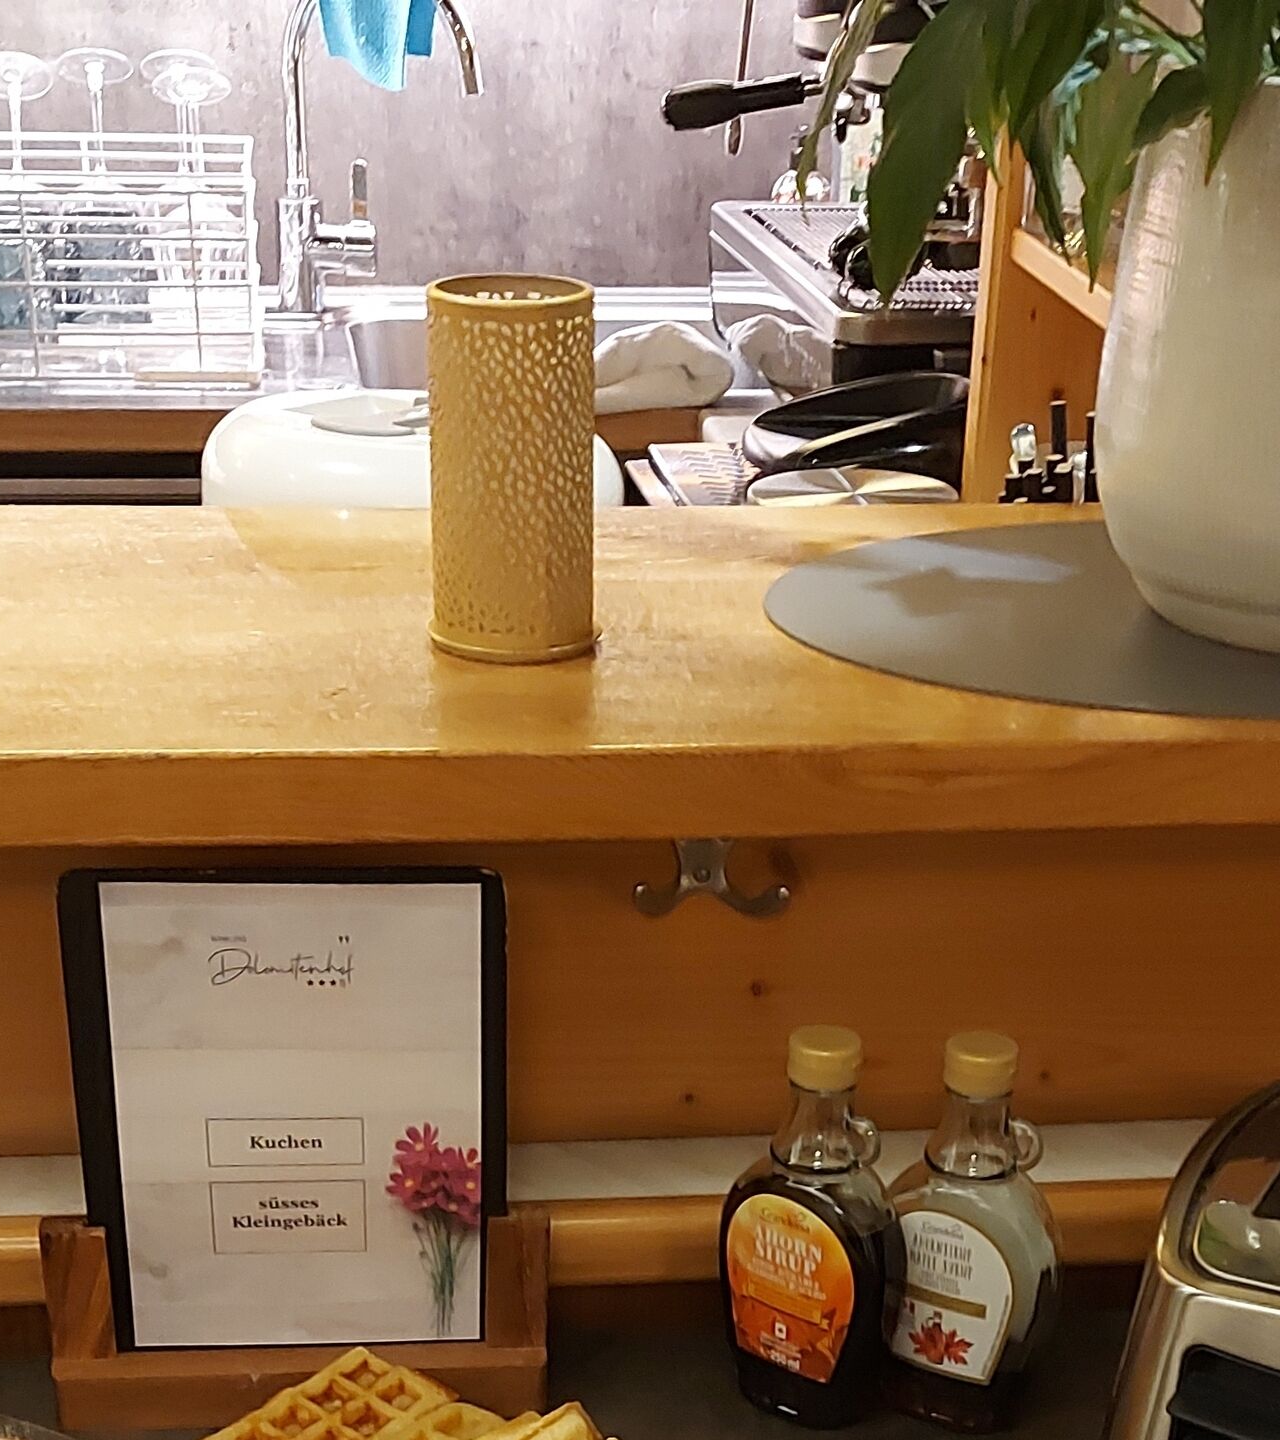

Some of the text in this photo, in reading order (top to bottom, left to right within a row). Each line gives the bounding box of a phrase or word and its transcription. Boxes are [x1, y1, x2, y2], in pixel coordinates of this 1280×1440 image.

[249, 1134, 323, 1150] Kuchen
[258, 1196, 320, 1210] süsses
[231, 1213, 349, 1231] Kleingebäck
[755, 1223, 823, 1264] AHORN
[754, 1239, 817, 1278] SIRUP
